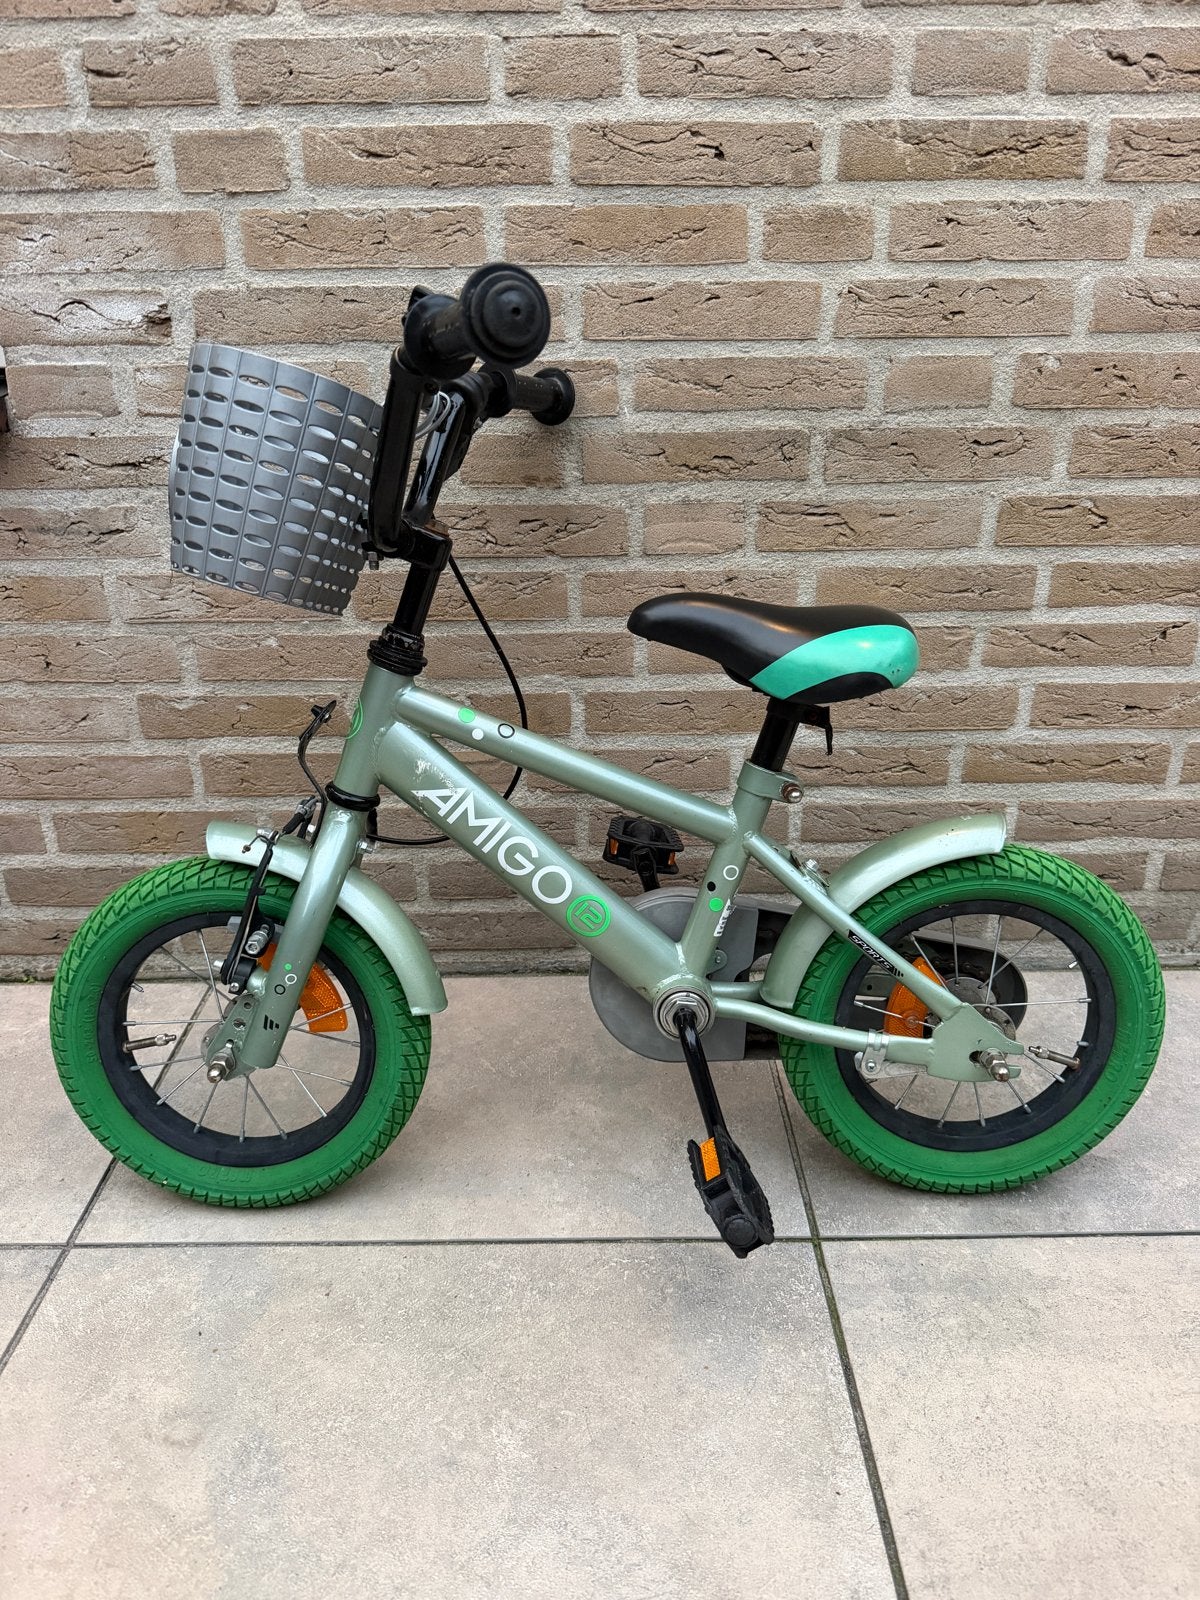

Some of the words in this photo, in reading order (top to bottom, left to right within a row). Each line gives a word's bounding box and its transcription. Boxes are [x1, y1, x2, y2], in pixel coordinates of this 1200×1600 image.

[411, 787, 573, 905] AMIGO
[573, 901, 605, 931] 12
[849, 934, 893, 970] SPORTS
